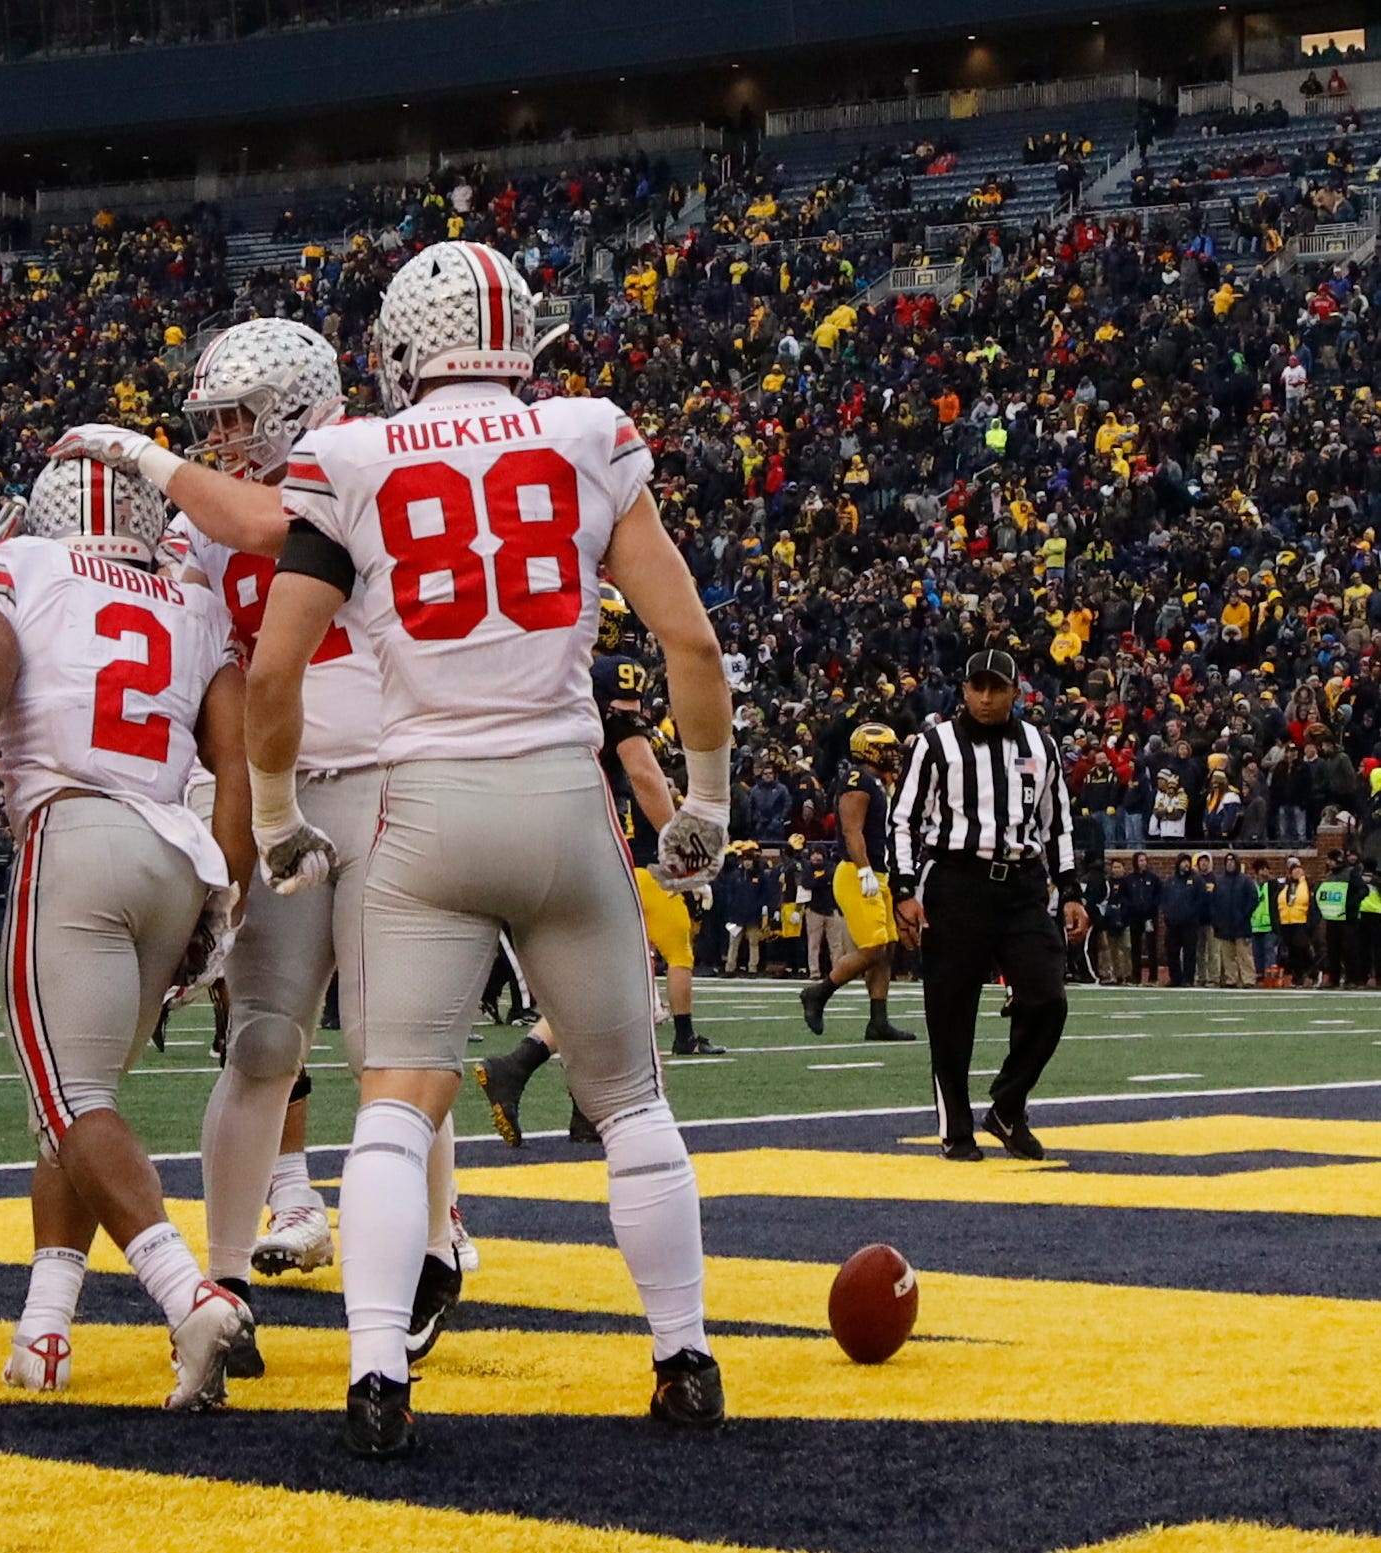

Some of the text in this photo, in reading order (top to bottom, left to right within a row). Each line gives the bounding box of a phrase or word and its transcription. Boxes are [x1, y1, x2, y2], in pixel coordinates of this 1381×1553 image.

[385, 408, 542, 454] RUCKERT
[67, 544, 138, 554] CKEYES
[376, 447, 582, 641] 88
[69, 551, 185, 606] DOBBINS
[91, 601, 172, 764] 2
[618, 663, 647, 693] 97
[847, 770, 861, 786] 2
[1023, 786, 1034, 804] B
